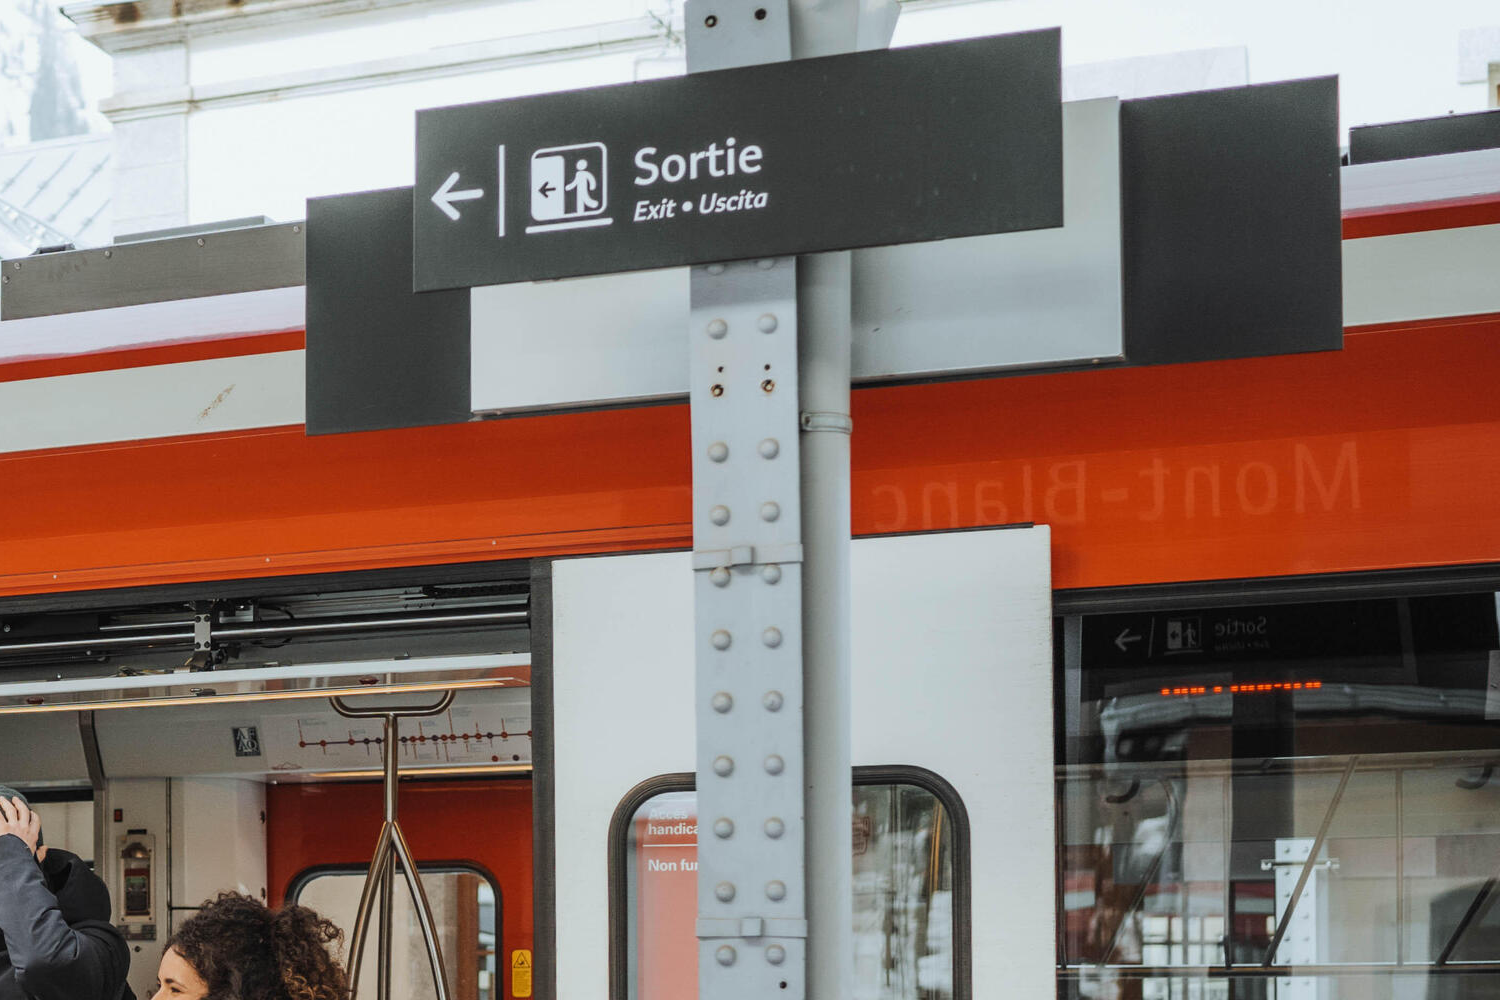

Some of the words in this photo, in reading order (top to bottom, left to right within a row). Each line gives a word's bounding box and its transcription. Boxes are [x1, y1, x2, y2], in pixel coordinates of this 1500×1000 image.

[634, 137, 763, 186] Sortie
[633, 198, 677, 222] Exit
[699, 189, 769, 214] Uscita
[648, 859, 677, 871] Non
